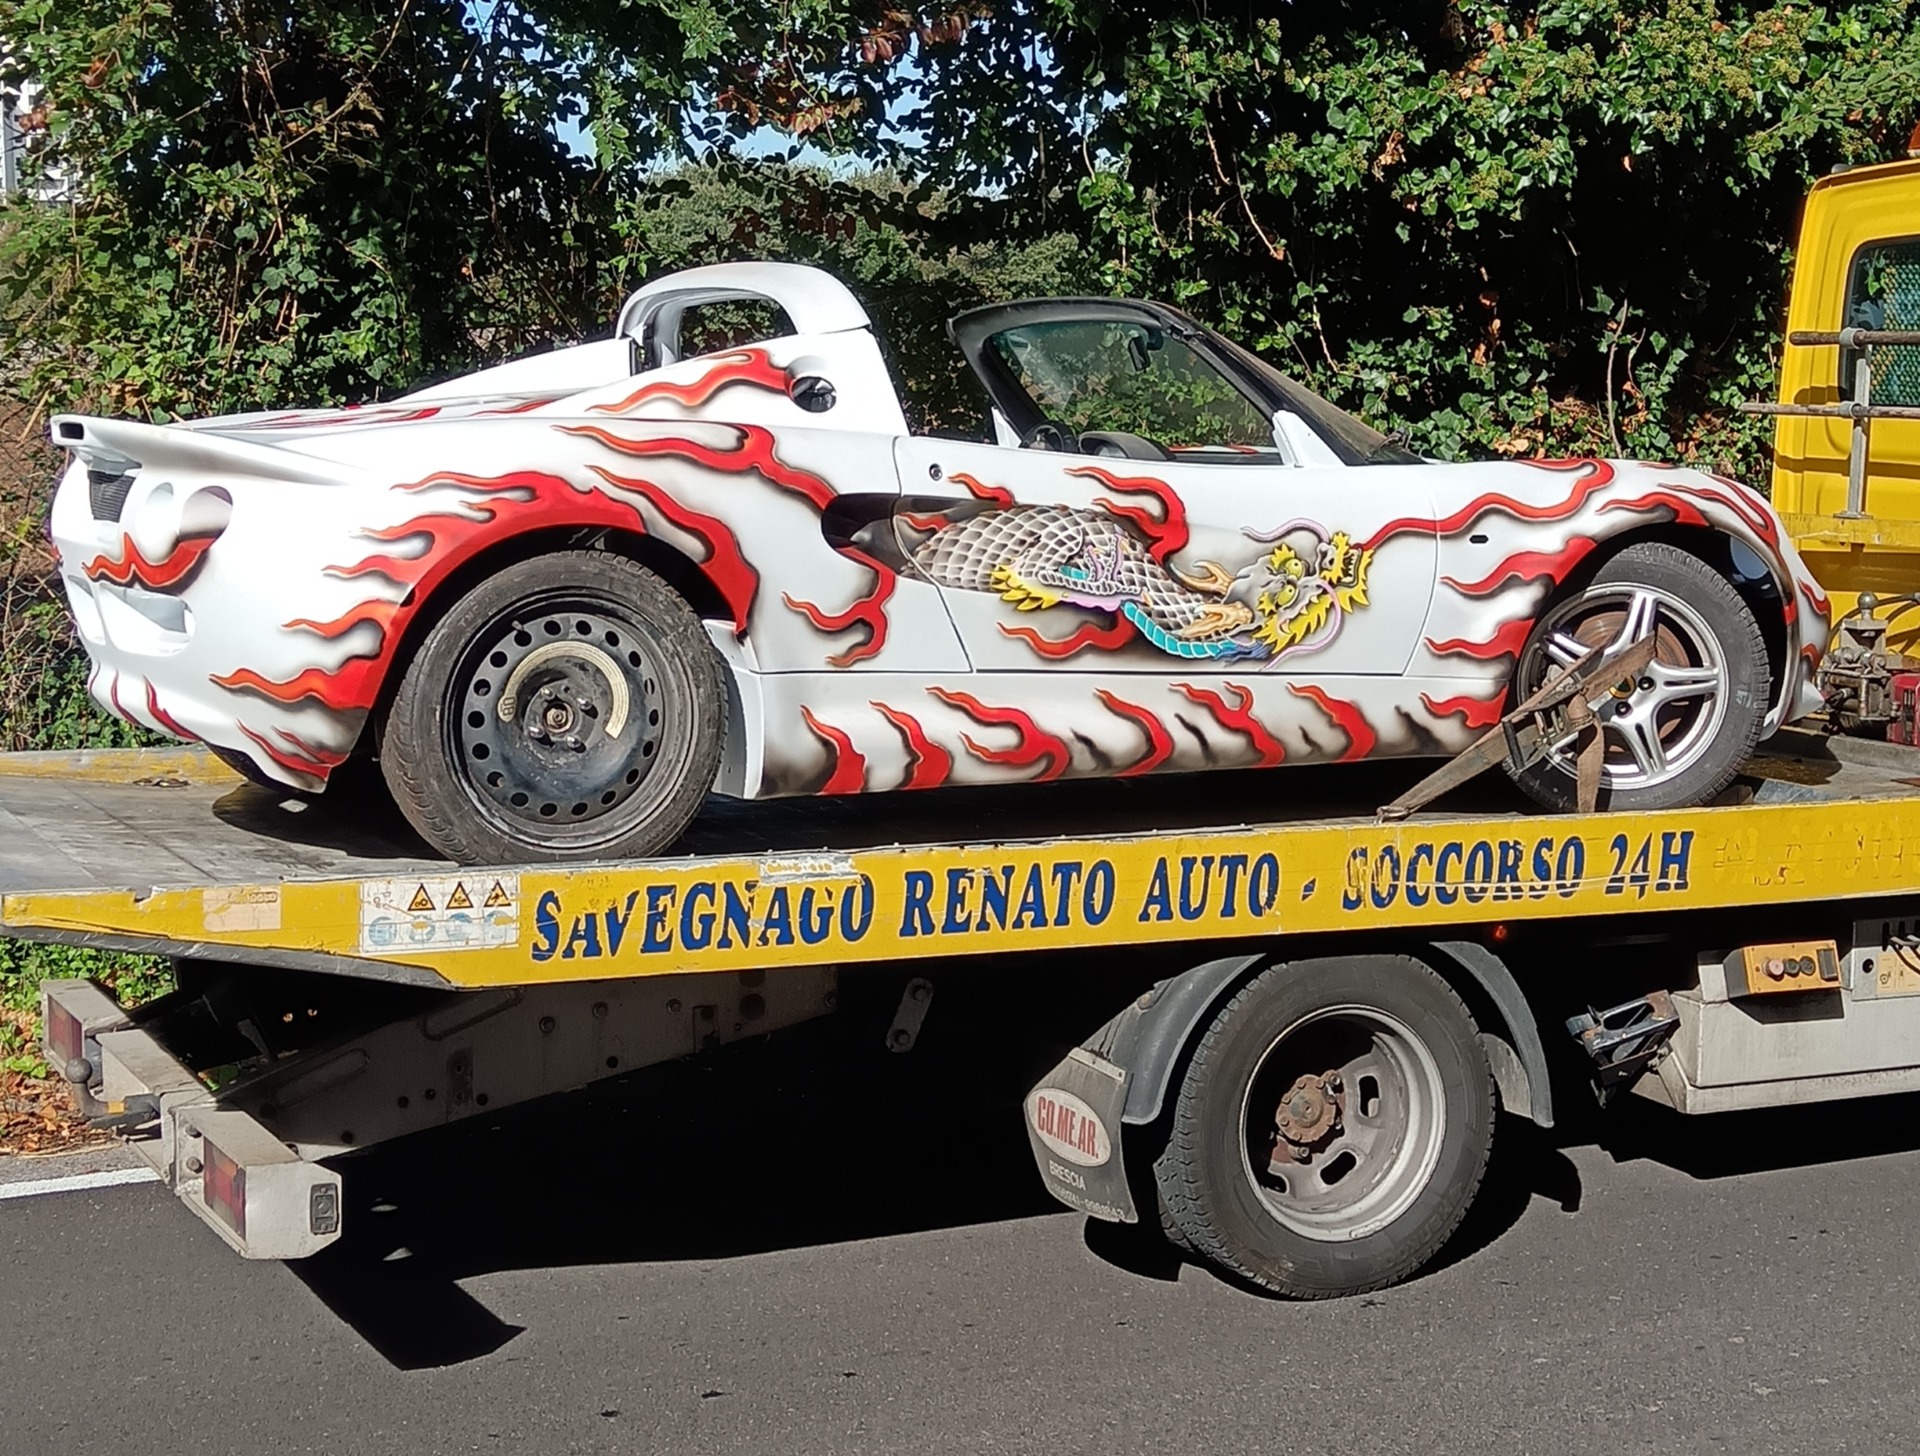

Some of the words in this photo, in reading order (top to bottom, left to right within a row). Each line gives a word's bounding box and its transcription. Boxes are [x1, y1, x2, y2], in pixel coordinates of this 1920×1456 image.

[532, 873, 873, 961] SAVEGNAGO
[899, 861, 1114, 938] RENATO
[1139, 853, 1279, 922] AUTO
[1342, 836, 1585, 911] SOCCORSO
[1606, 831, 1695, 899] 24H
[1038, 1096, 1099, 1159] CO.ME.AR.
[1049, 1160, 1086, 1191] BRESCIA
